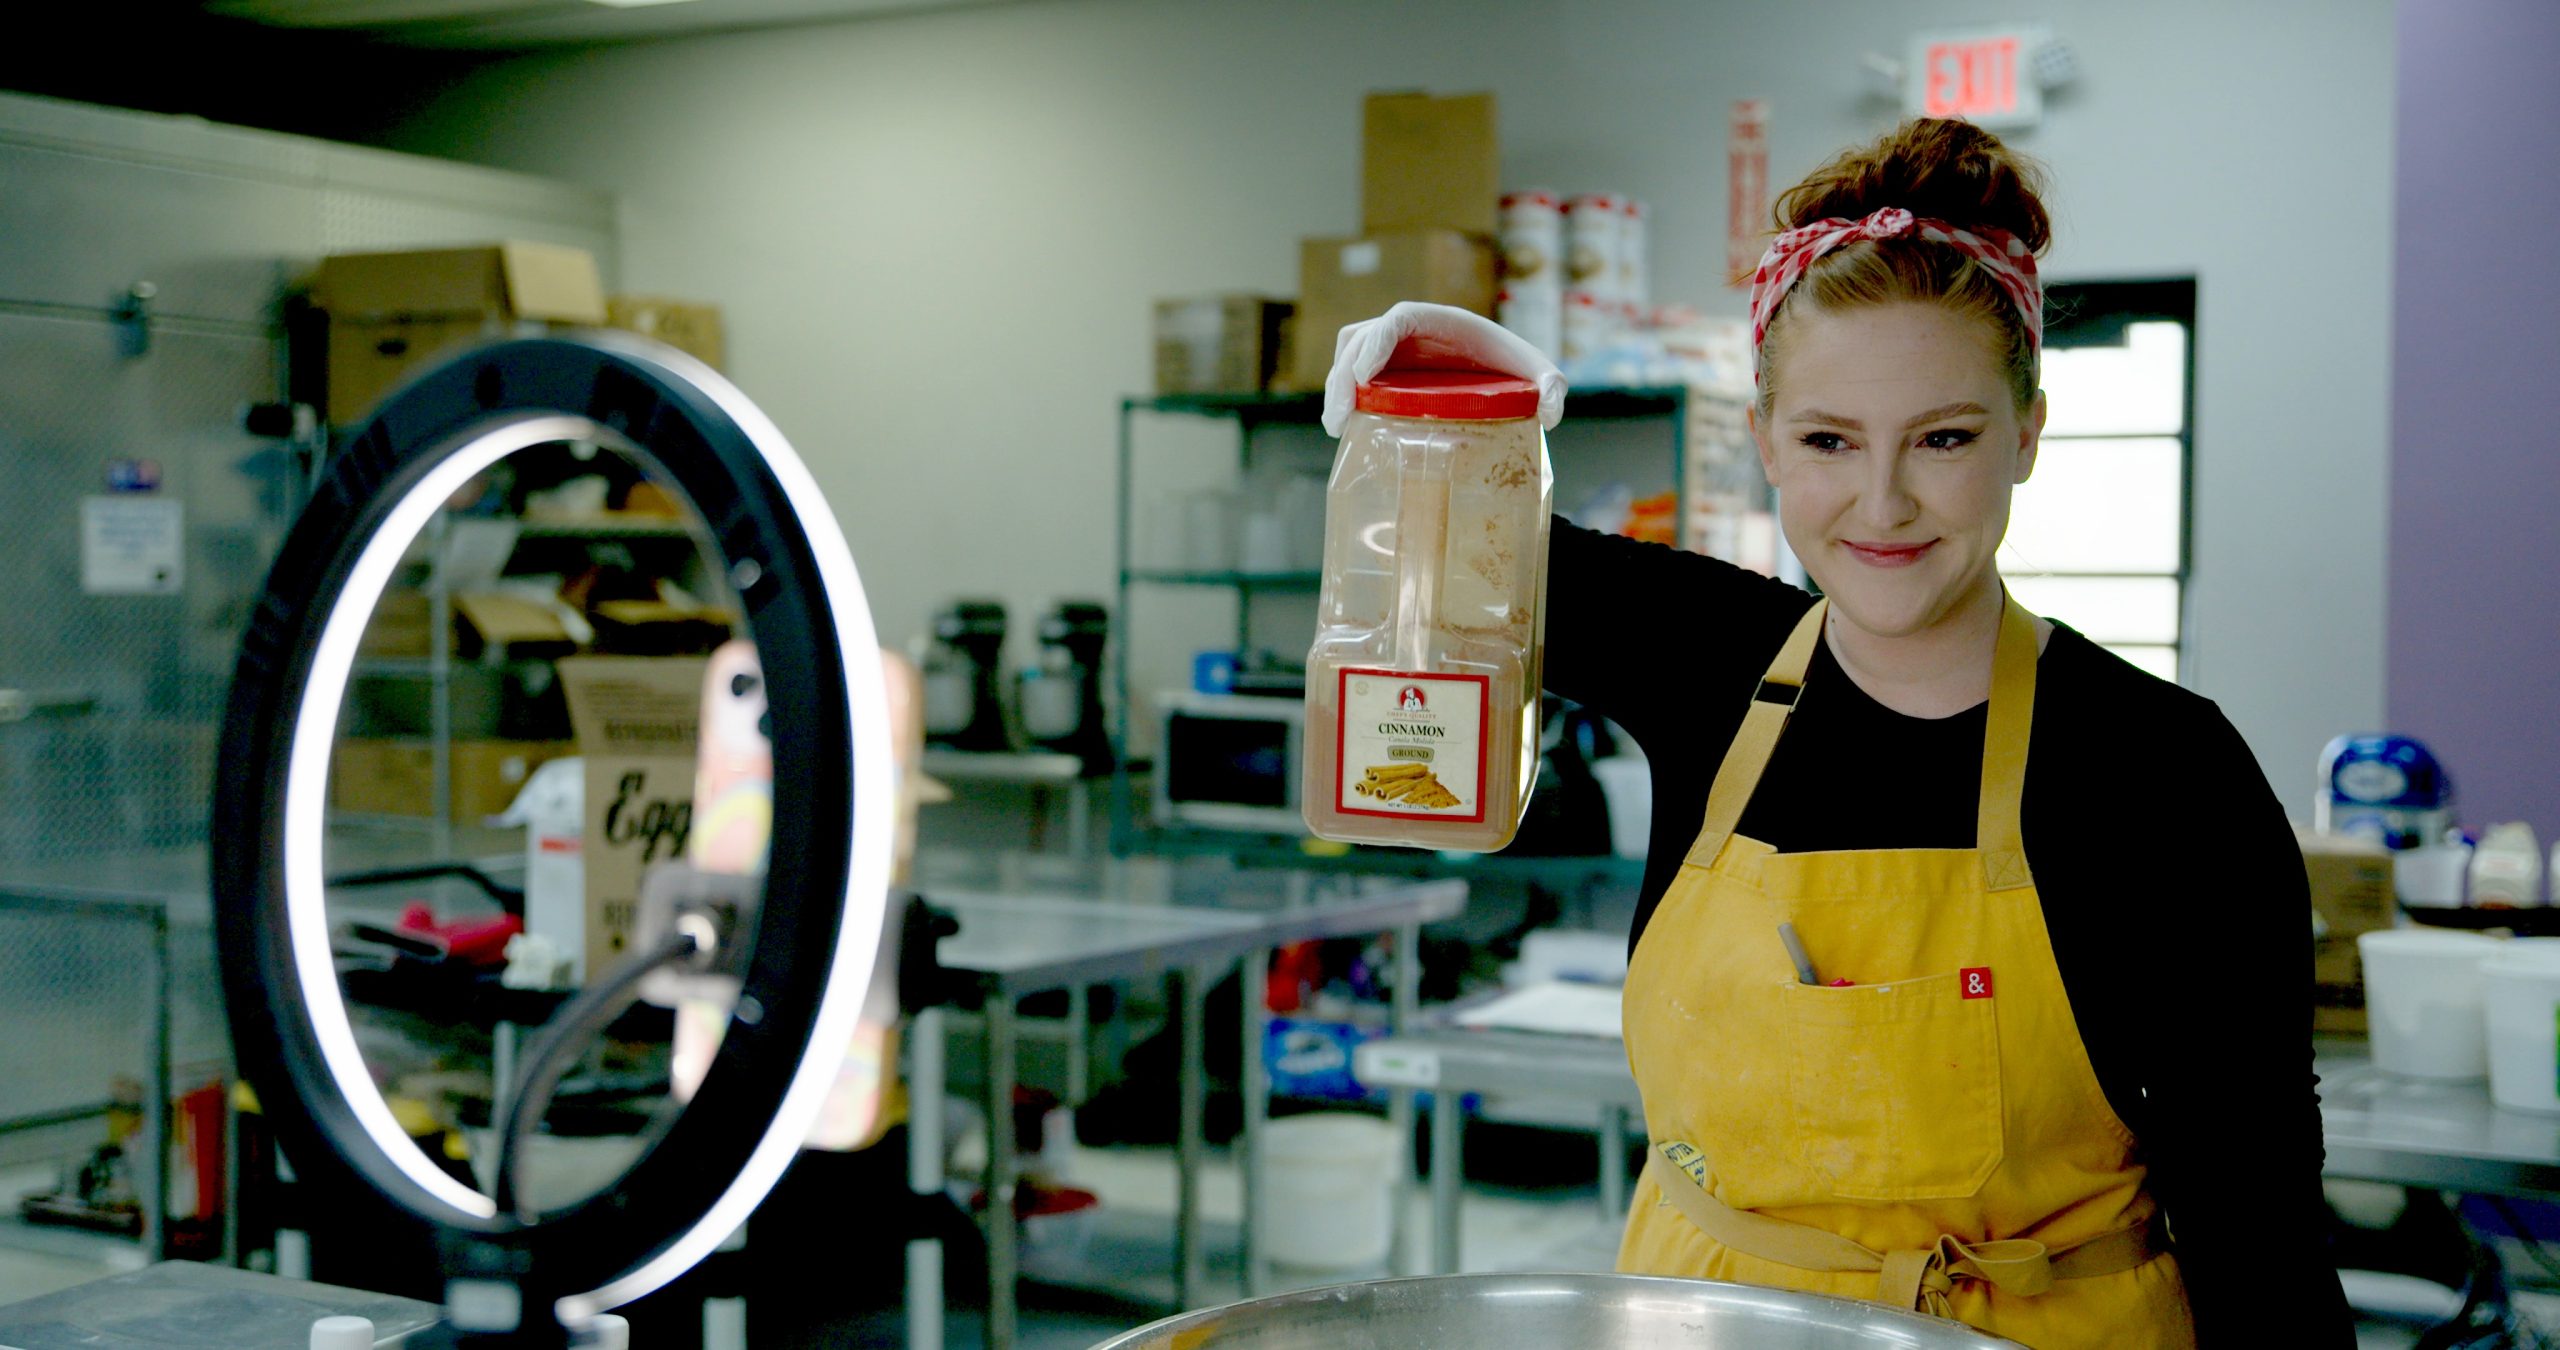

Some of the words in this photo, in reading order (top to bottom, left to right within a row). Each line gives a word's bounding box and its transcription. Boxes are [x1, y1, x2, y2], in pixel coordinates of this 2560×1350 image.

[1926, 39, 2018, 116] EXIT
[1378, 723, 1445, 738] CINNAMON
[1392, 748, 1430, 760] GROUND
[1968, 972, 1986, 995] &
